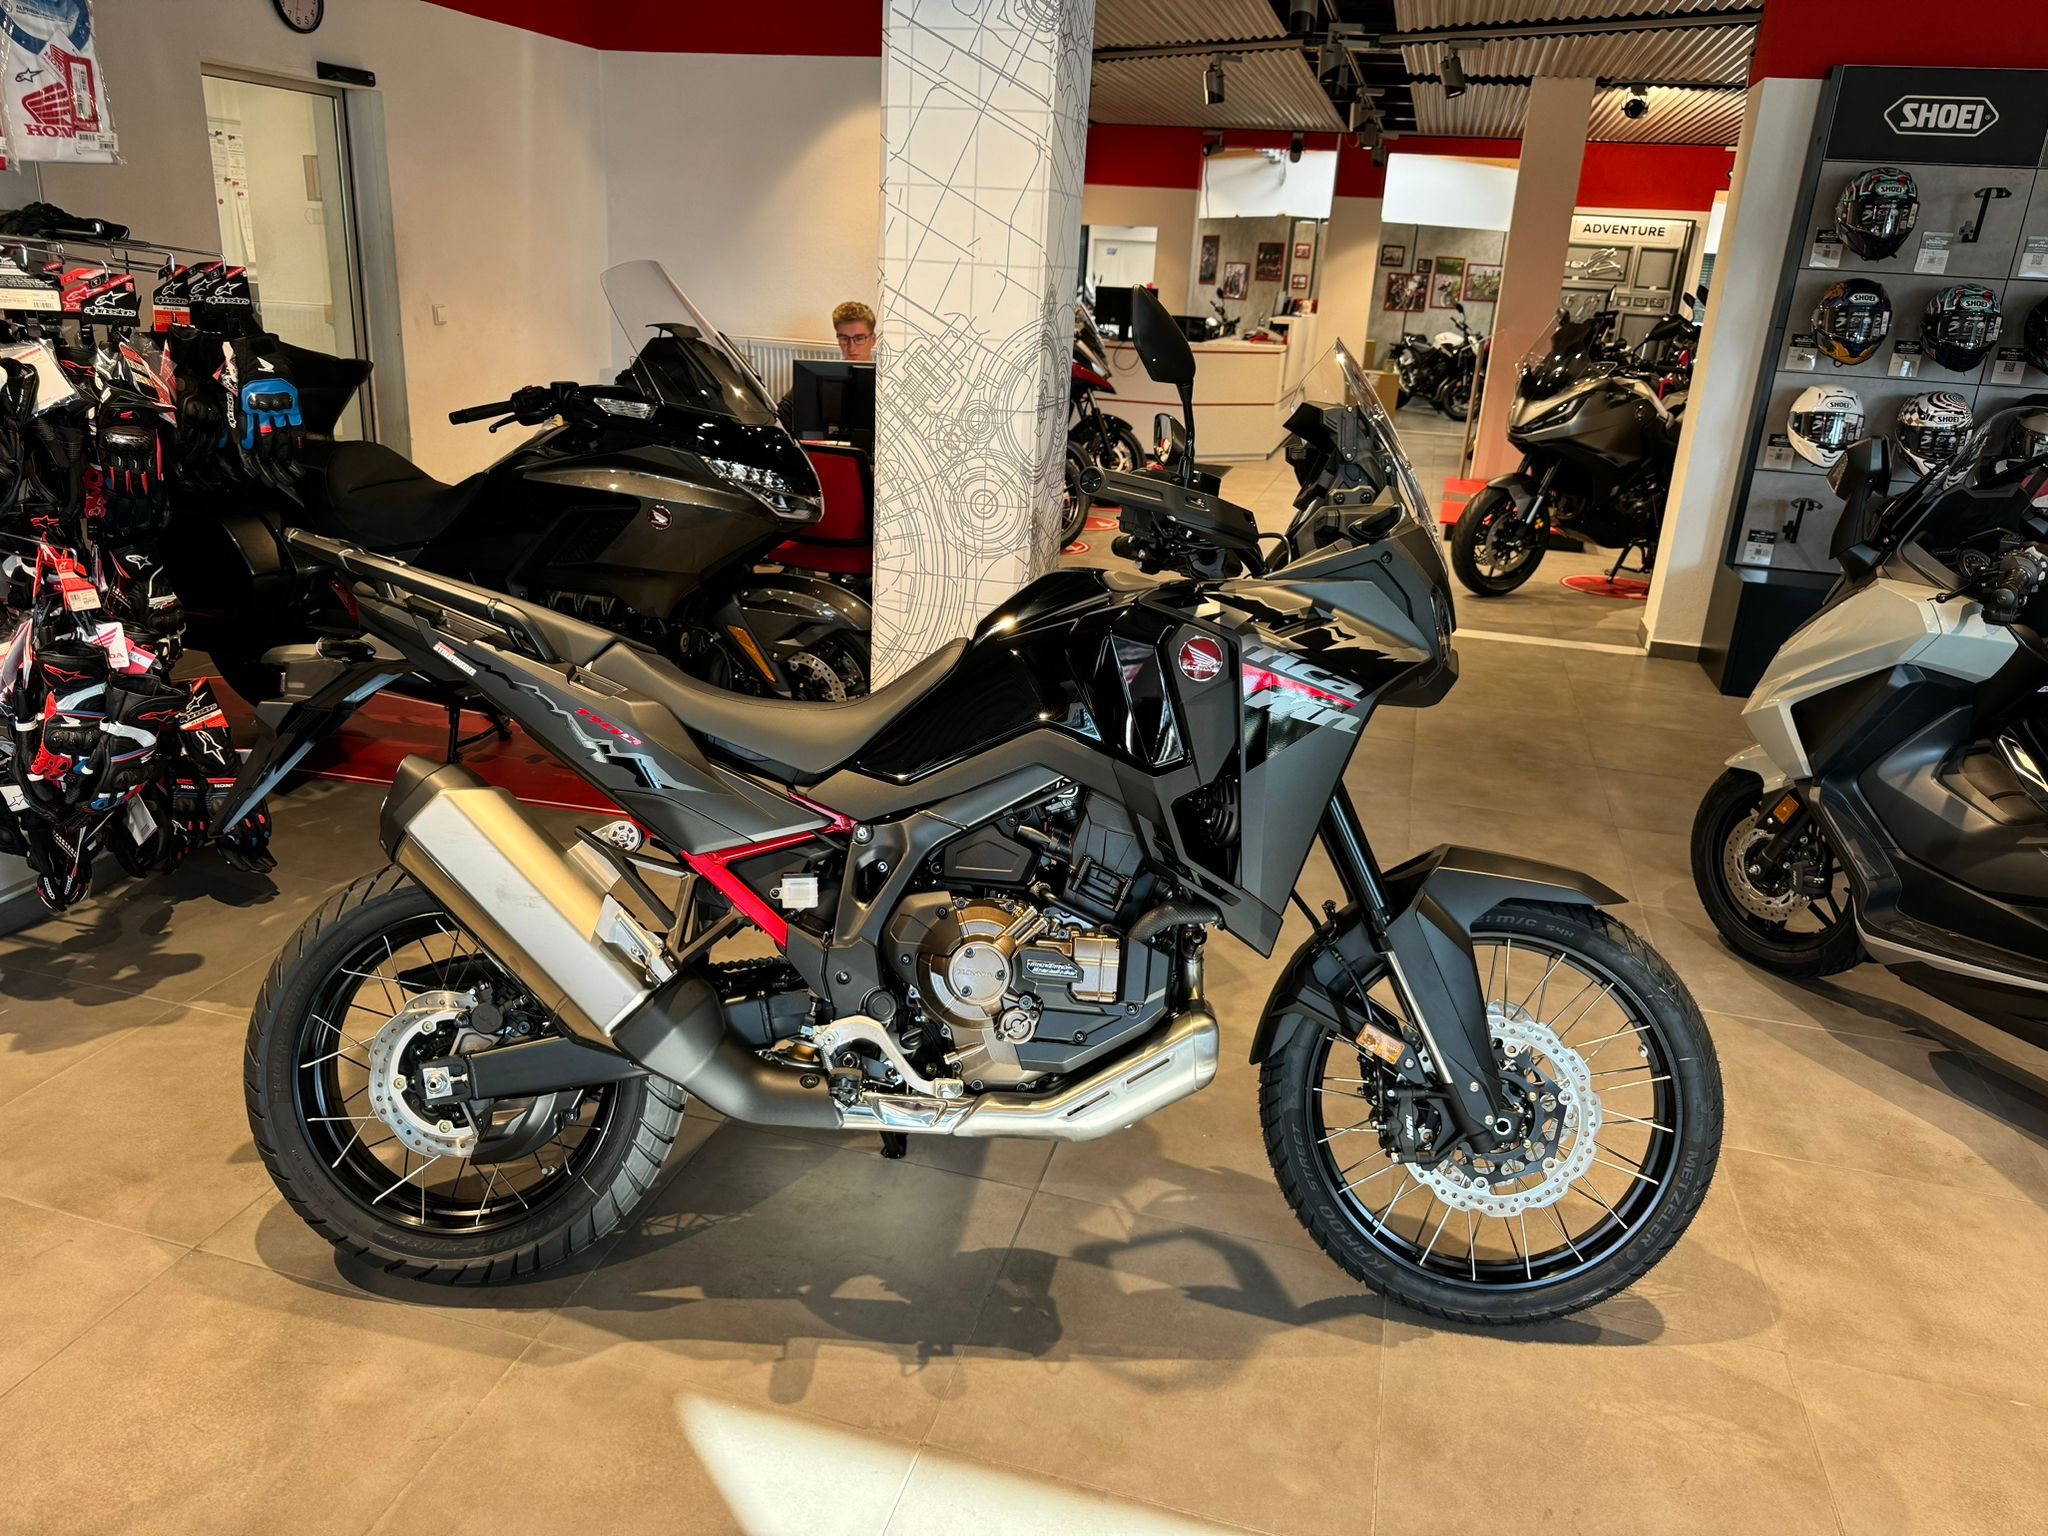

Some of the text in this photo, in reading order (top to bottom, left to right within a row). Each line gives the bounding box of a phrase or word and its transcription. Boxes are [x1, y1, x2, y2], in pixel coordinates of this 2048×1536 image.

[1900, 103, 1985, 129] SHOEI
[1582, 223, 1666, 237] ADVENTURE
[1854, 294, 1876, 302] SHOEI
[1965, 299, 1988, 308] SHOEI
[1292, 1122, 1388, 1270] KAROO STREET
[1640, 1150, 1699, 1248] METZELER
